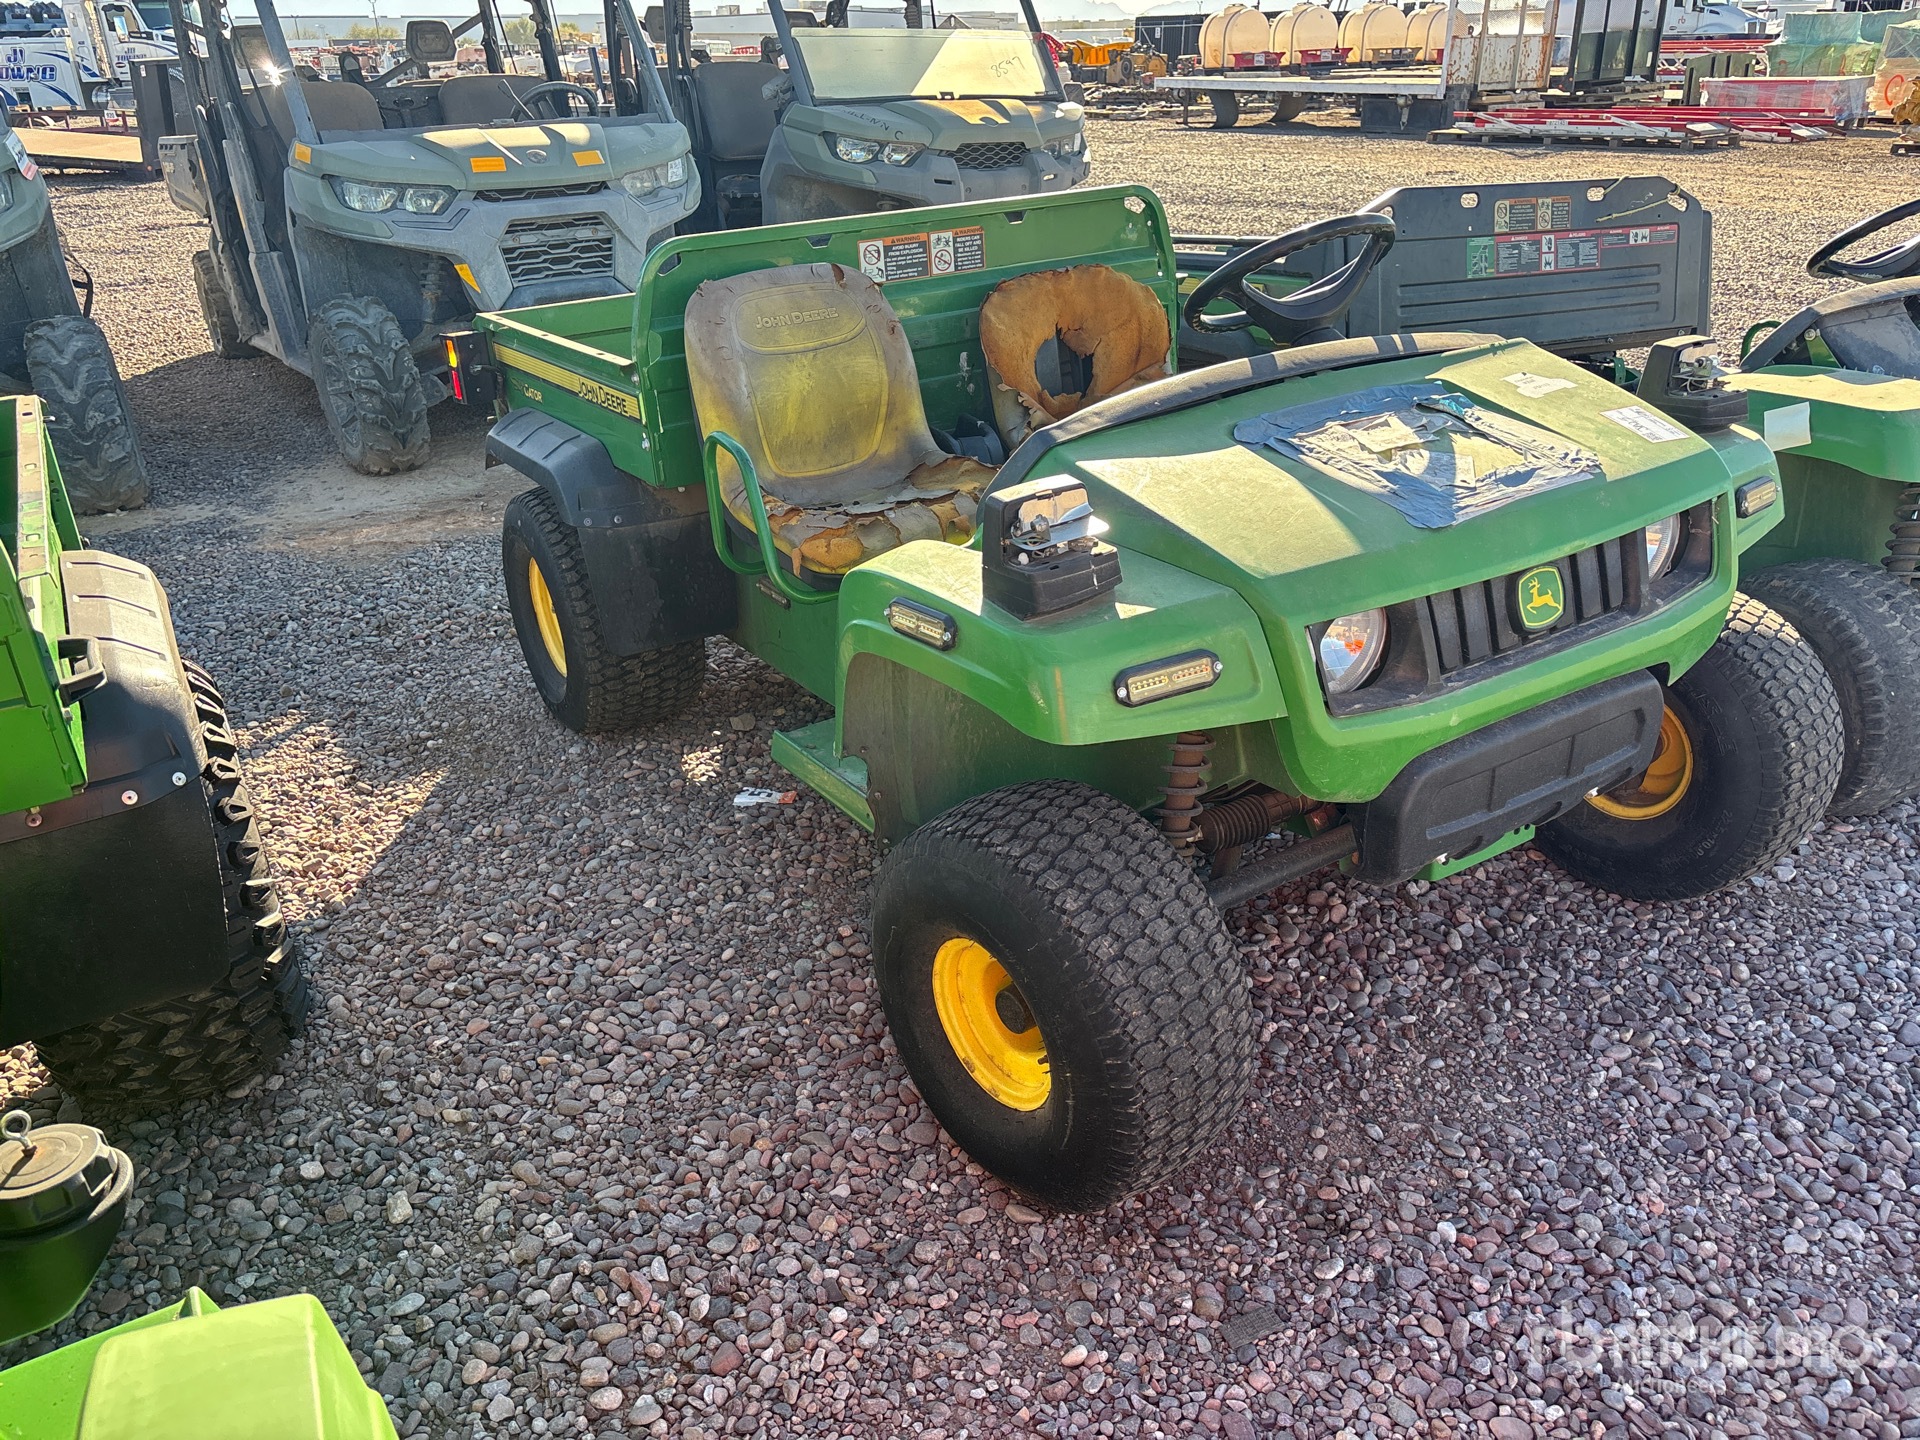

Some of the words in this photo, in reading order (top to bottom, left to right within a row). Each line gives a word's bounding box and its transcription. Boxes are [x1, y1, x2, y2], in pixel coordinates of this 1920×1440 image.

[756, 314, 791, 329] JOHN
[791, 307, 839, 324] DEERE
[577, 377, 599, 404] JOHN
[598, 386, 629, 416] DEERE
